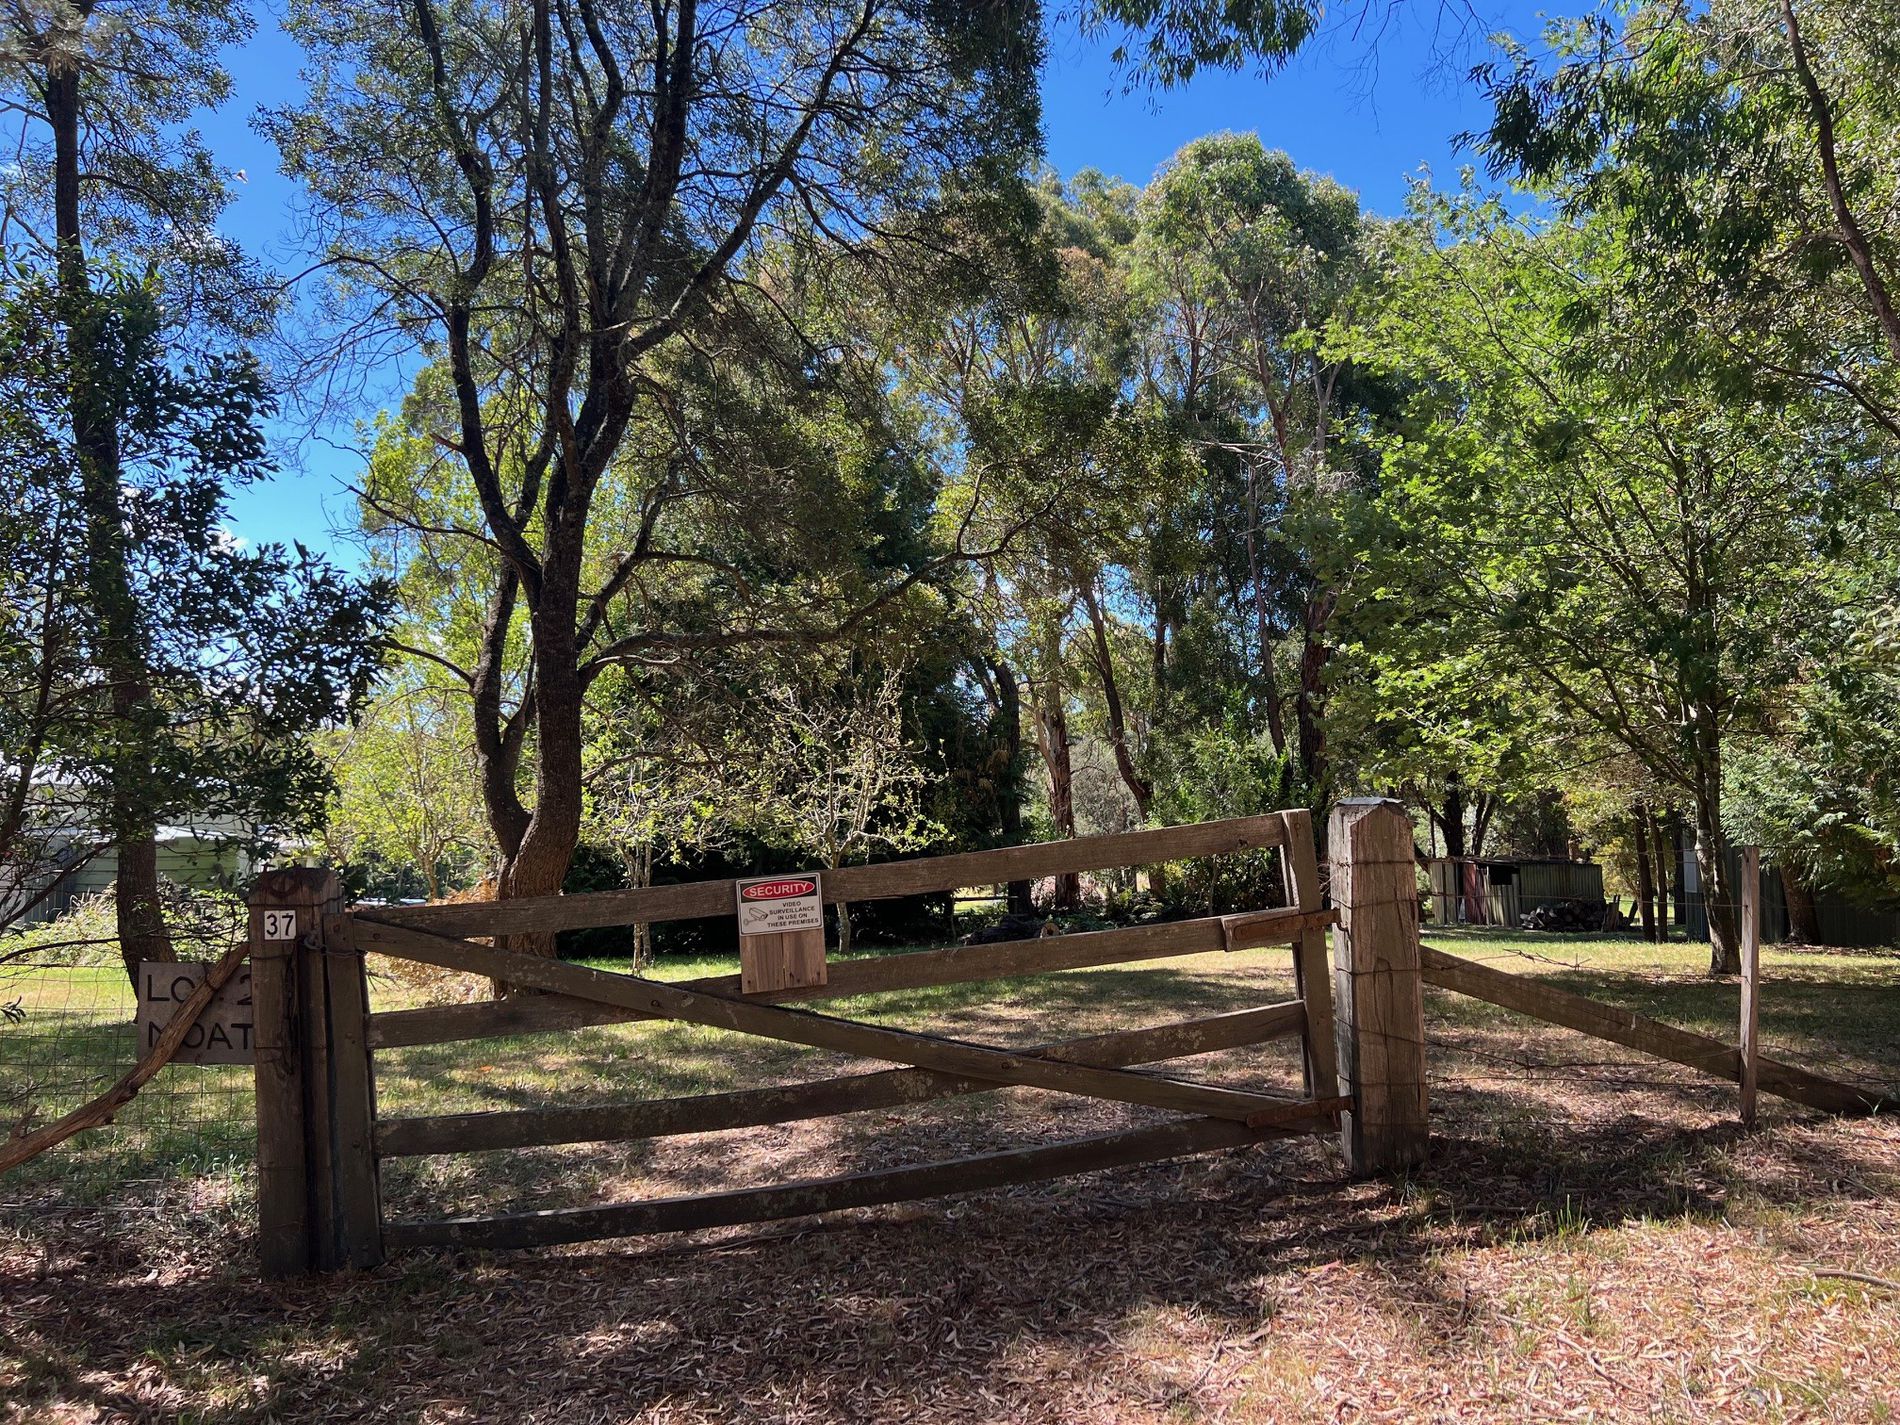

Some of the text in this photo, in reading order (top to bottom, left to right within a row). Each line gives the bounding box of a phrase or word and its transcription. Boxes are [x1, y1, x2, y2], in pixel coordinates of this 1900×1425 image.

[749, 882, 808, 897] SECURITY
[769, 905, 815, 915] SURVEILLANCE
[266, 914, 294, 936] 37
